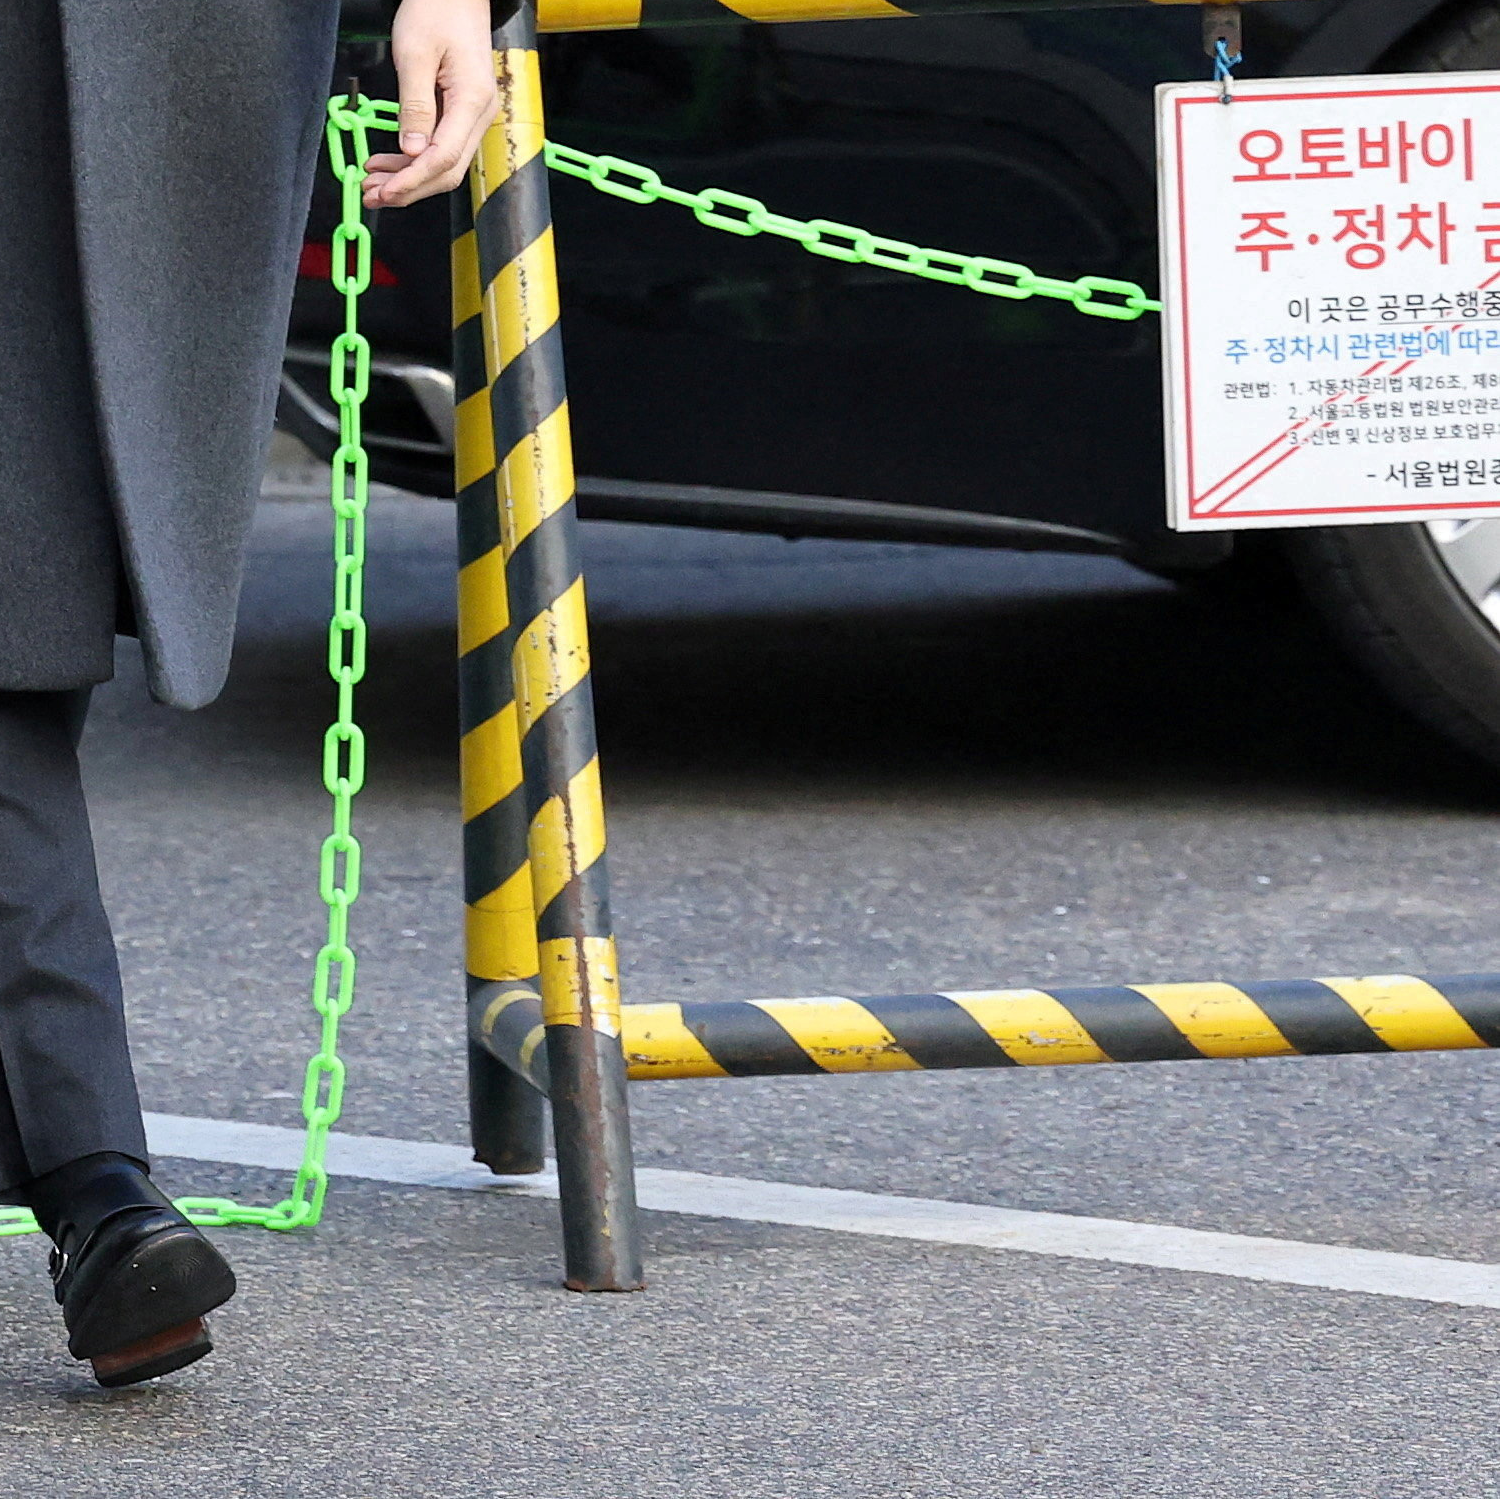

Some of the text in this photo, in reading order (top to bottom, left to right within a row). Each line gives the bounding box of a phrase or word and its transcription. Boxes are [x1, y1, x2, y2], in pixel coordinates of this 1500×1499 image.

[1233, 118, 1473, 183] 오토바이
[1235, 202, 1456, 272] 주·정차
[1288, 291, 1500, 323] 이 곳은 공무수행중
[1347, 330, 1450, 359] 관련법에
[1224, 381, 1277, 399] 관련법:
[1289, 382, 1302, 395] 1.
[1308, 376, 1402, 397] 자동차관리법
[1409, 374, 1467, 391] 제26조,
[1309, 401, 1403, 420] 서울고등법원
[1311, 427, 1340, 446] 신변
[1346, 427, 1360, 445] 및
[1367, 425, 1428, 444] 신상정보
[1433, 422, 1500, 441] 보호업무
